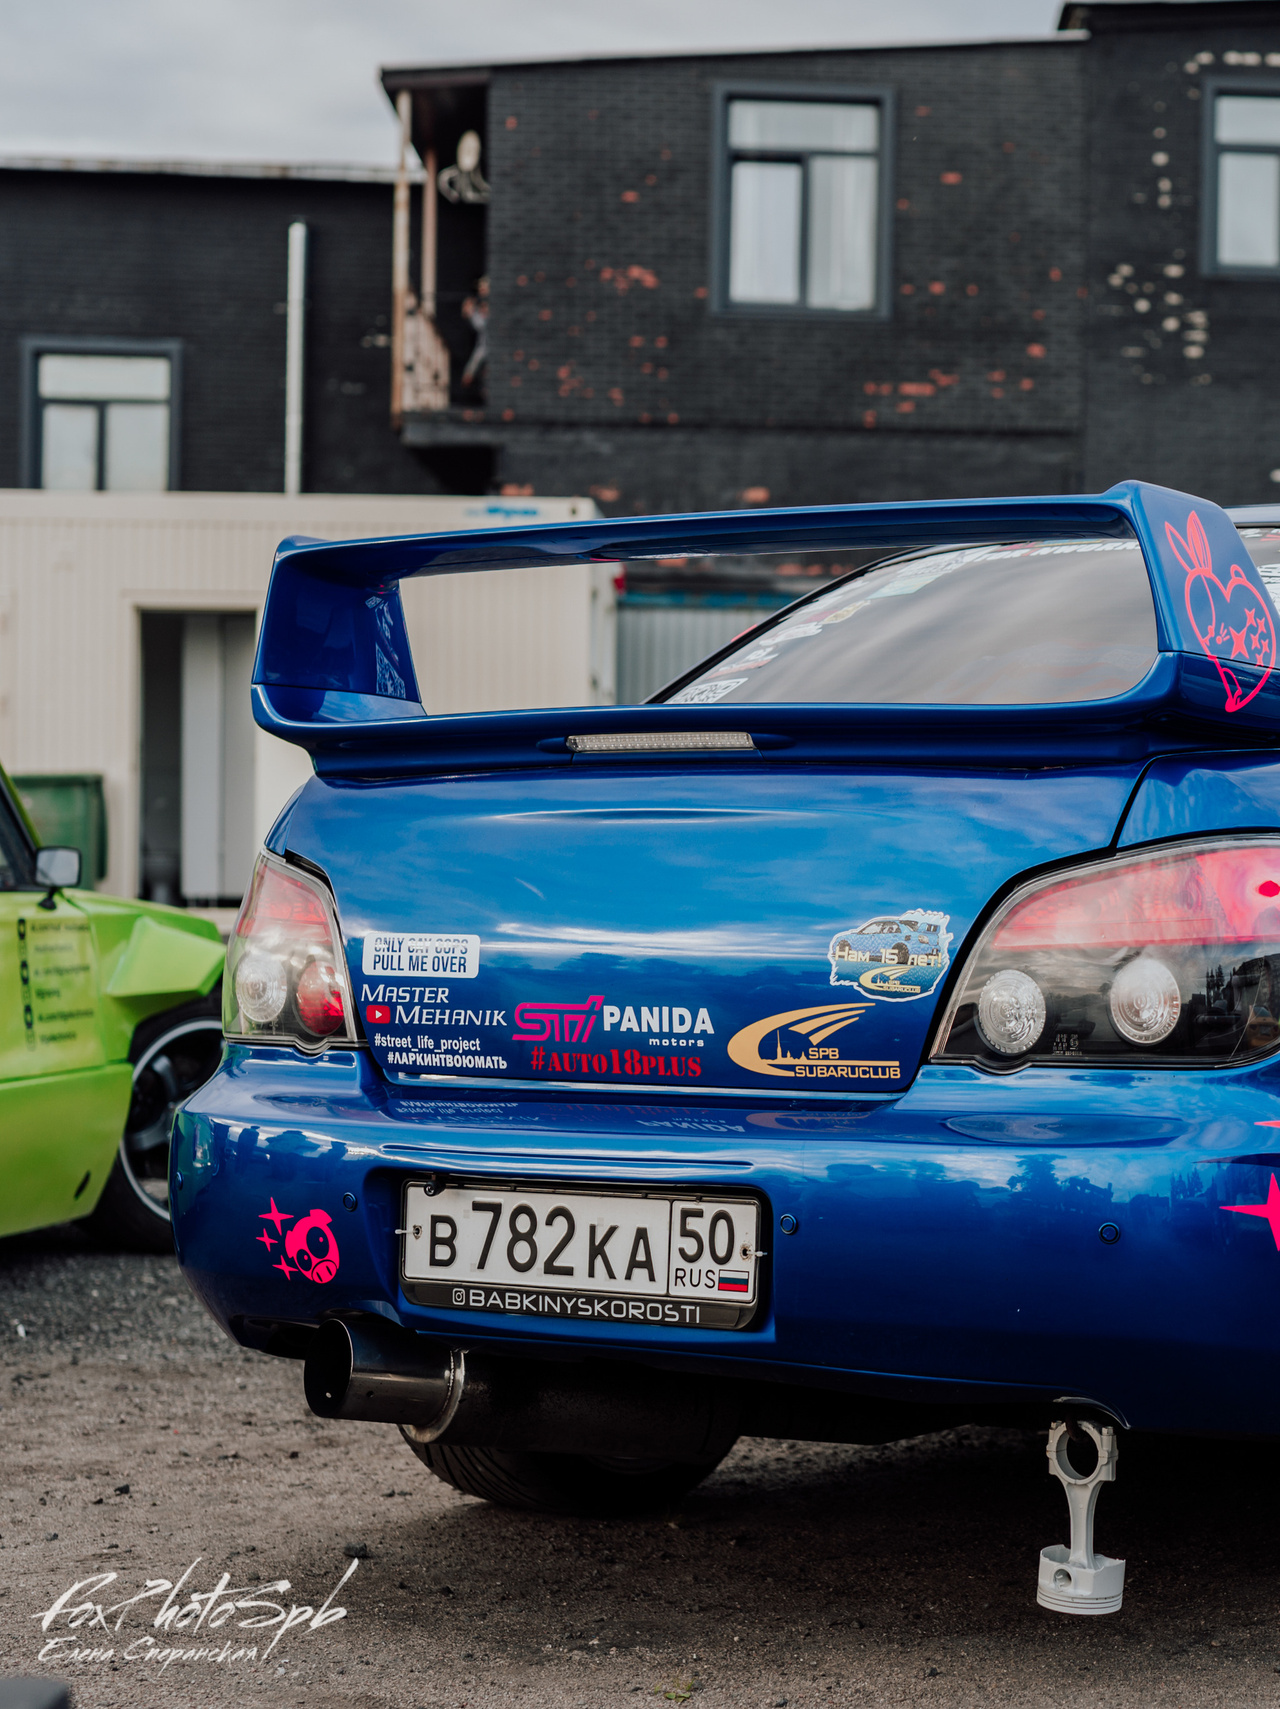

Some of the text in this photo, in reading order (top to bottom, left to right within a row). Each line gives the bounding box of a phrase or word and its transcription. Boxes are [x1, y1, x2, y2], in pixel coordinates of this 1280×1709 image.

[374, 937, 405, 953] ONLY
[435, 938, 469, 955] COPS
[373, 954, 467, 973] PULL ME OVER
[835, 946, 942, 967] Нам 15 лет!
[603, 1006, 715, 1034] PANIDA
[374, 1033, 481, 1053] #street_life_project
[648, 1038, 705, 1048] motors
[386, 1052, 508, 1070] #ЛАРКИНТВОЮМАТЬ
[530, 1046, 702, 1077] #AUTO18PLUS
[808, 1047, 840, 1060] SPB
[795, 1065, 901, 1079] SUBARUCLUB
[677, 1207, 736, 1266] 50
[674, 1267, 716, 1290] RUS
[469, 1289, 700, 1325] BABKINYSKOROSTI
